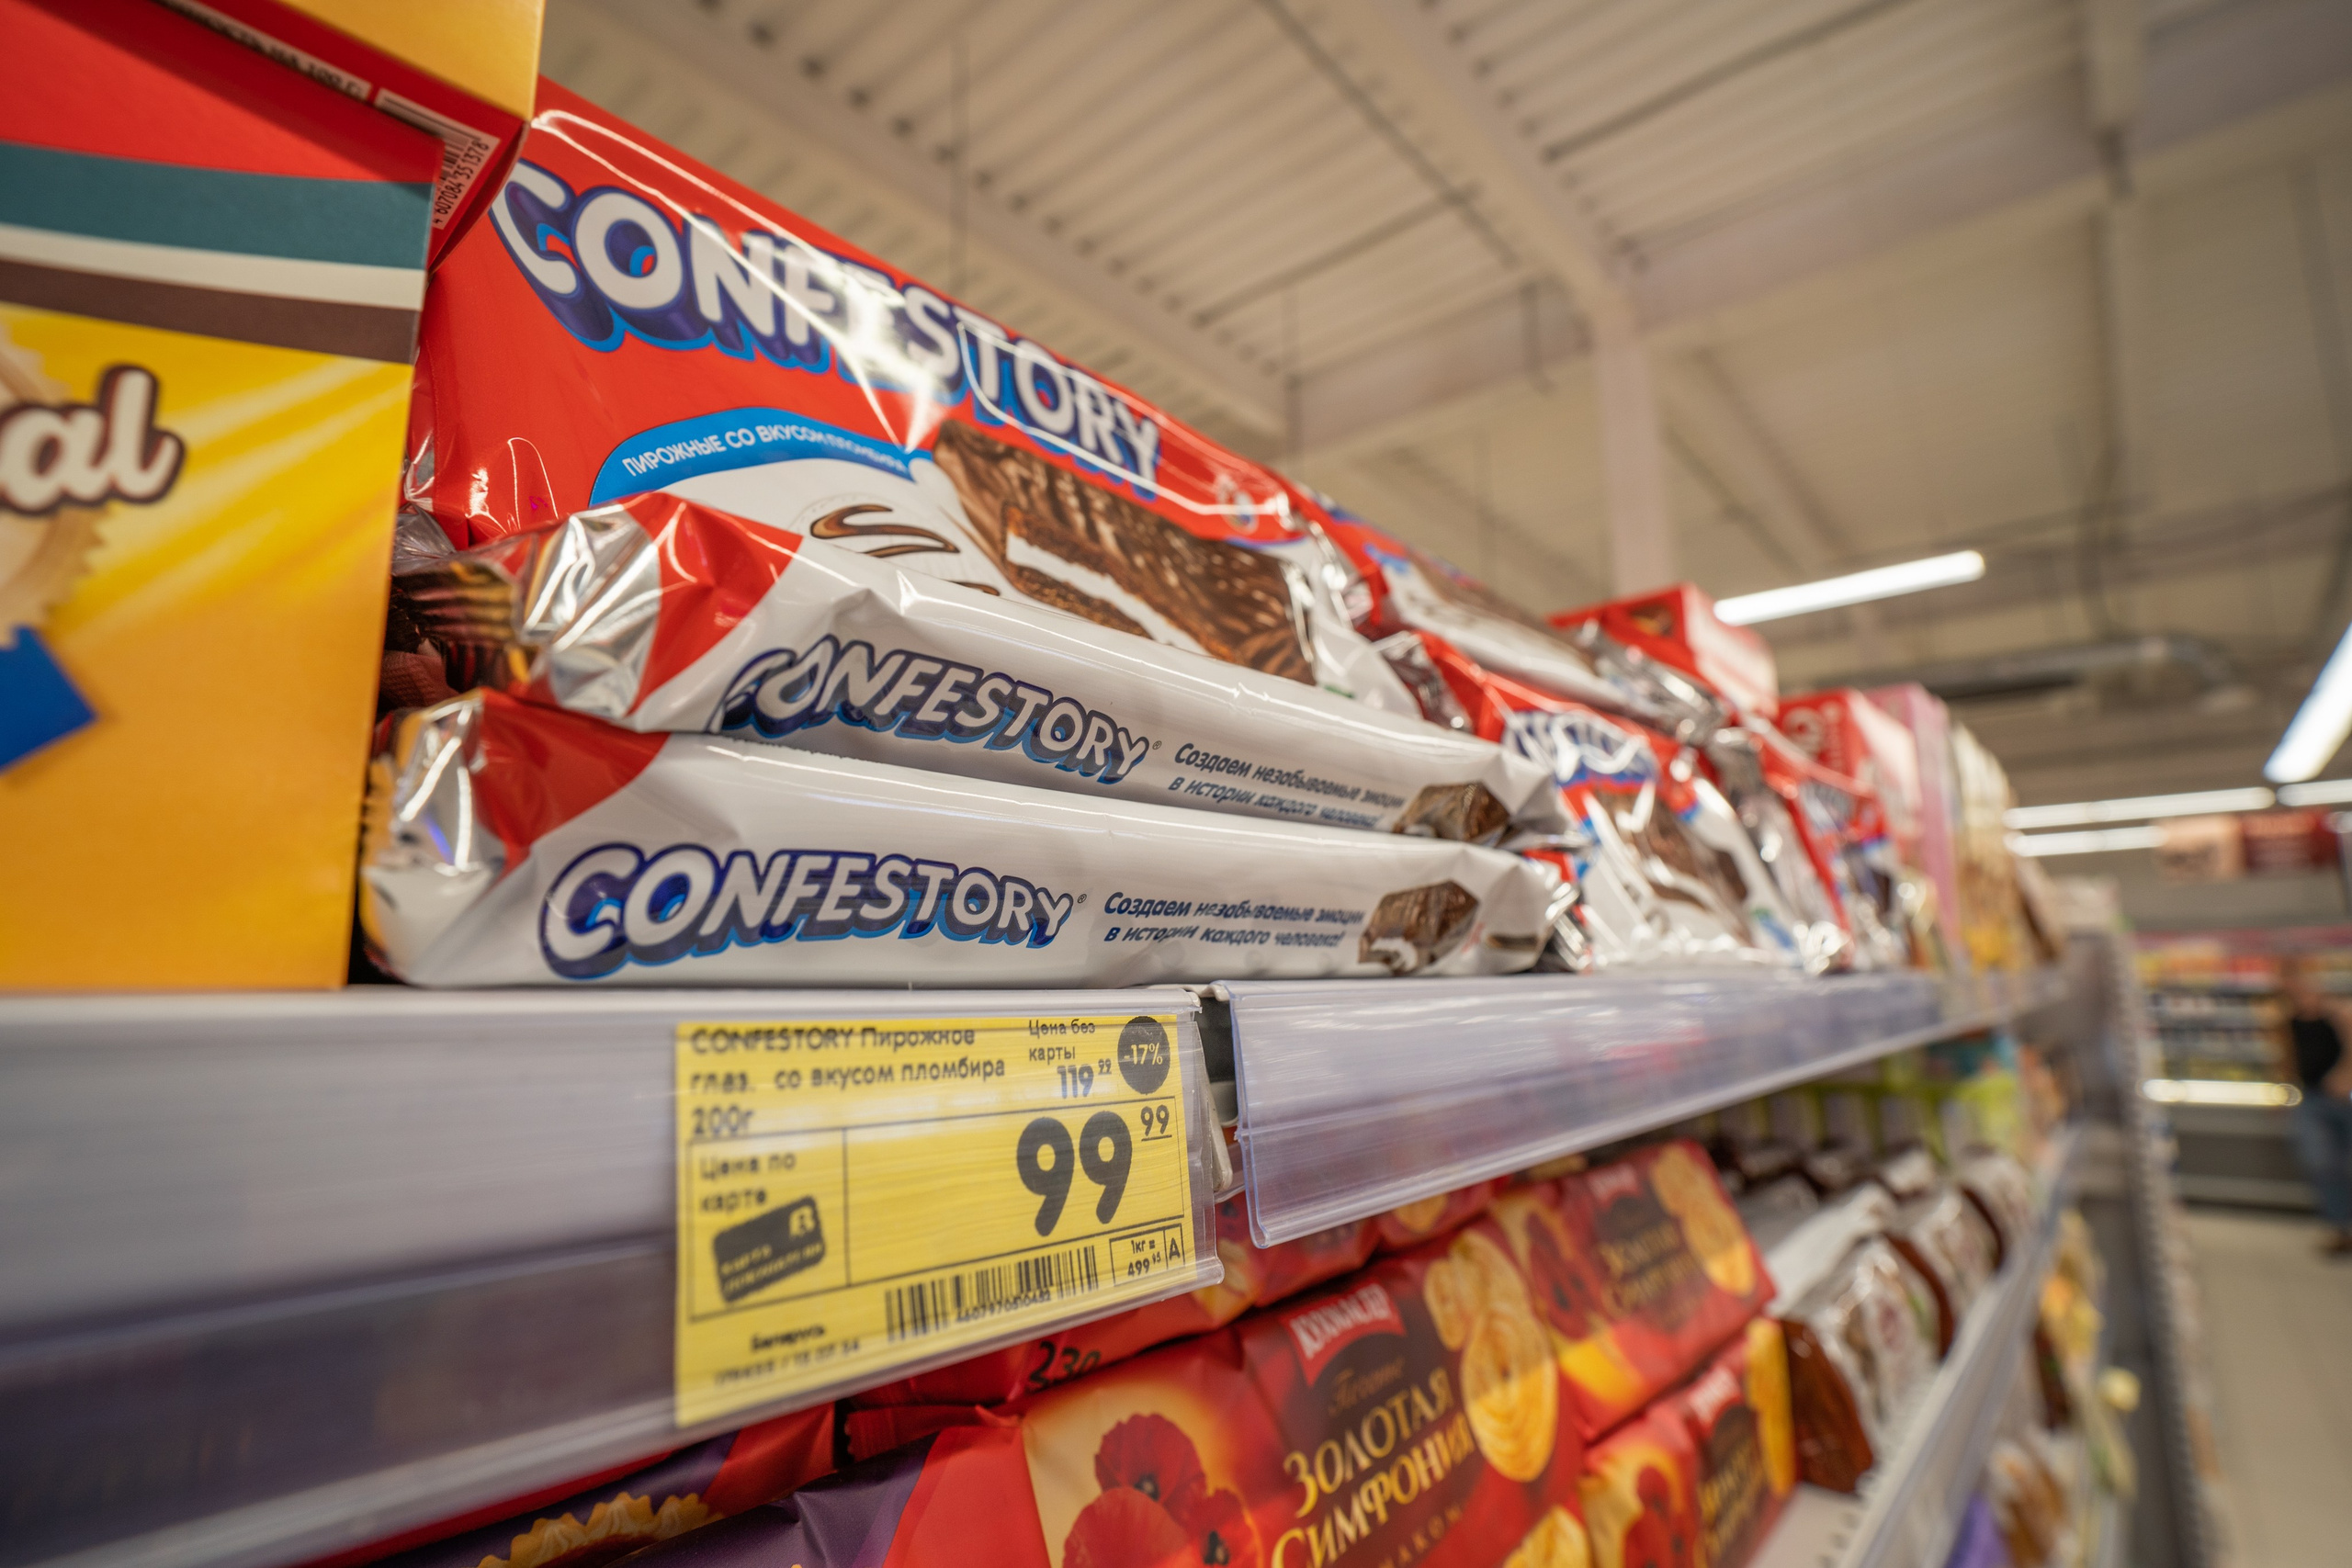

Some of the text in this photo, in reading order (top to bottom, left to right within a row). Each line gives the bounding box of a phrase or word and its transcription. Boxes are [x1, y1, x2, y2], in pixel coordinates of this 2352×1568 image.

[622, 434, 727, 477] ПИРОЖНЫЕ
[724, 428, 756, 447] СО
[755, 424, 829, 446] ВКУСОМ
[705, 633, 1150, 785] CONFESTORY
[1174, 742, 1252, 779] Создаем
[1168, 776, 1185, 792] в
[1183, 779, 1257, 805] истории
[538, 841, 1075, 979] CONFESTORY
[1103, 891, 1193, 919] Создаем
[1193, 899, 1315, 922] незабываемые
[1103, 927, 1121, 942] в
[1121, 925, 1199, 944] истории
[1199, 927, 1272, 947] каждого
[690, 1025, 976, 1055] CONFESTORY Пирожное
[1029, 1018, 1096, 1038] Цена без
[1029, 1045, 1076, 1066] карты
[1123, 1042, 1163, 1066] -17%
[775, 1068, 802, 1091] со
[810, 1063, 895, 1091] вкусом
[900, 1056, 1006, 1083] пломбира
[1057, 1063, 1094, 1100] 119
[1016, 1104, 1170, 1237] 99 99
[1127, 1258, 1150, 1278] 499
[1283, 1367, 1454, 1519] ЗОЛОТАЯ
